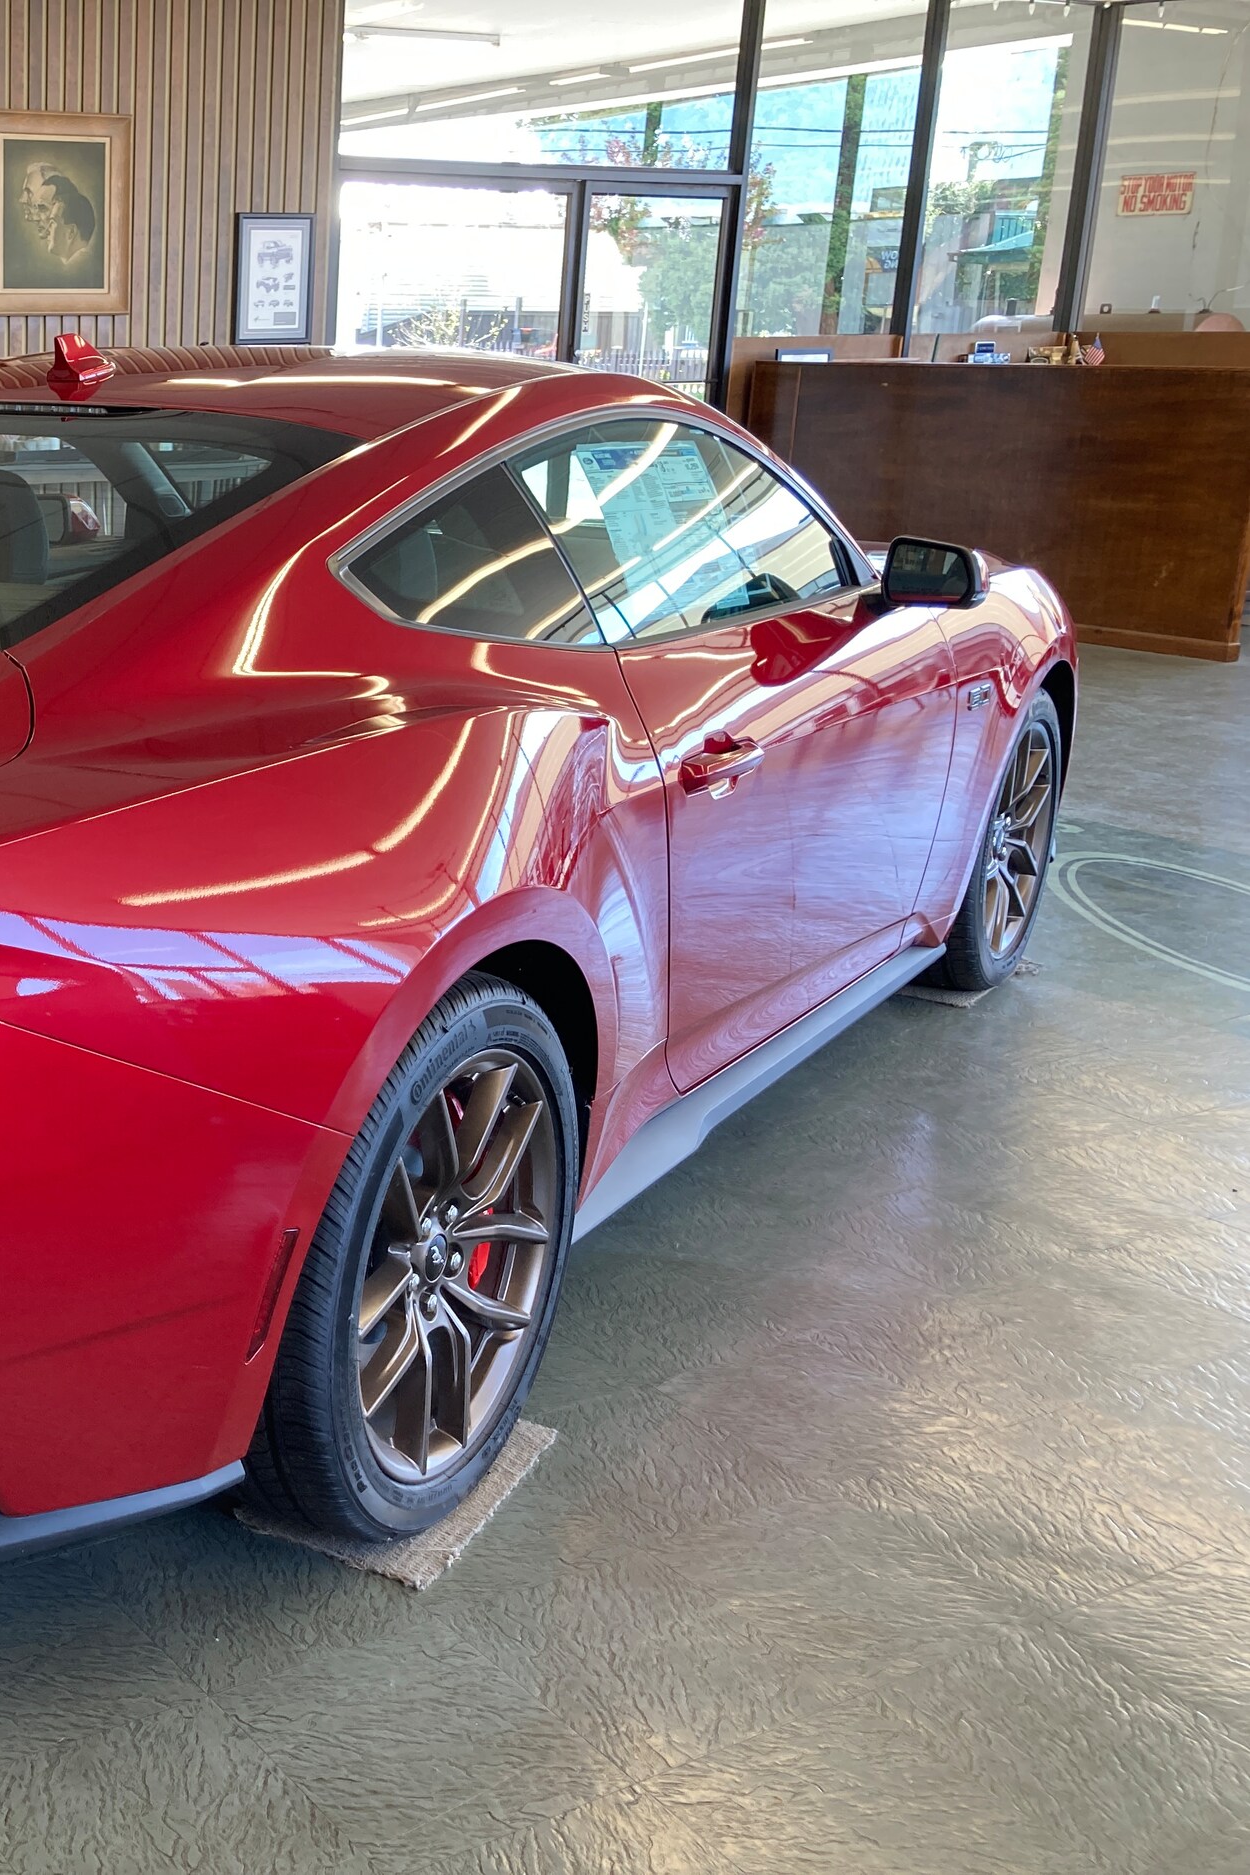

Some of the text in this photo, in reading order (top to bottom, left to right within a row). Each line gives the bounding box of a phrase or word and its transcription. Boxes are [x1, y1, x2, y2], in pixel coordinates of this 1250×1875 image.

[1120, 173, 1196, 195] STOP YOUR MOTOR
[1121, 193, 1188, 213] NO SMOKING
